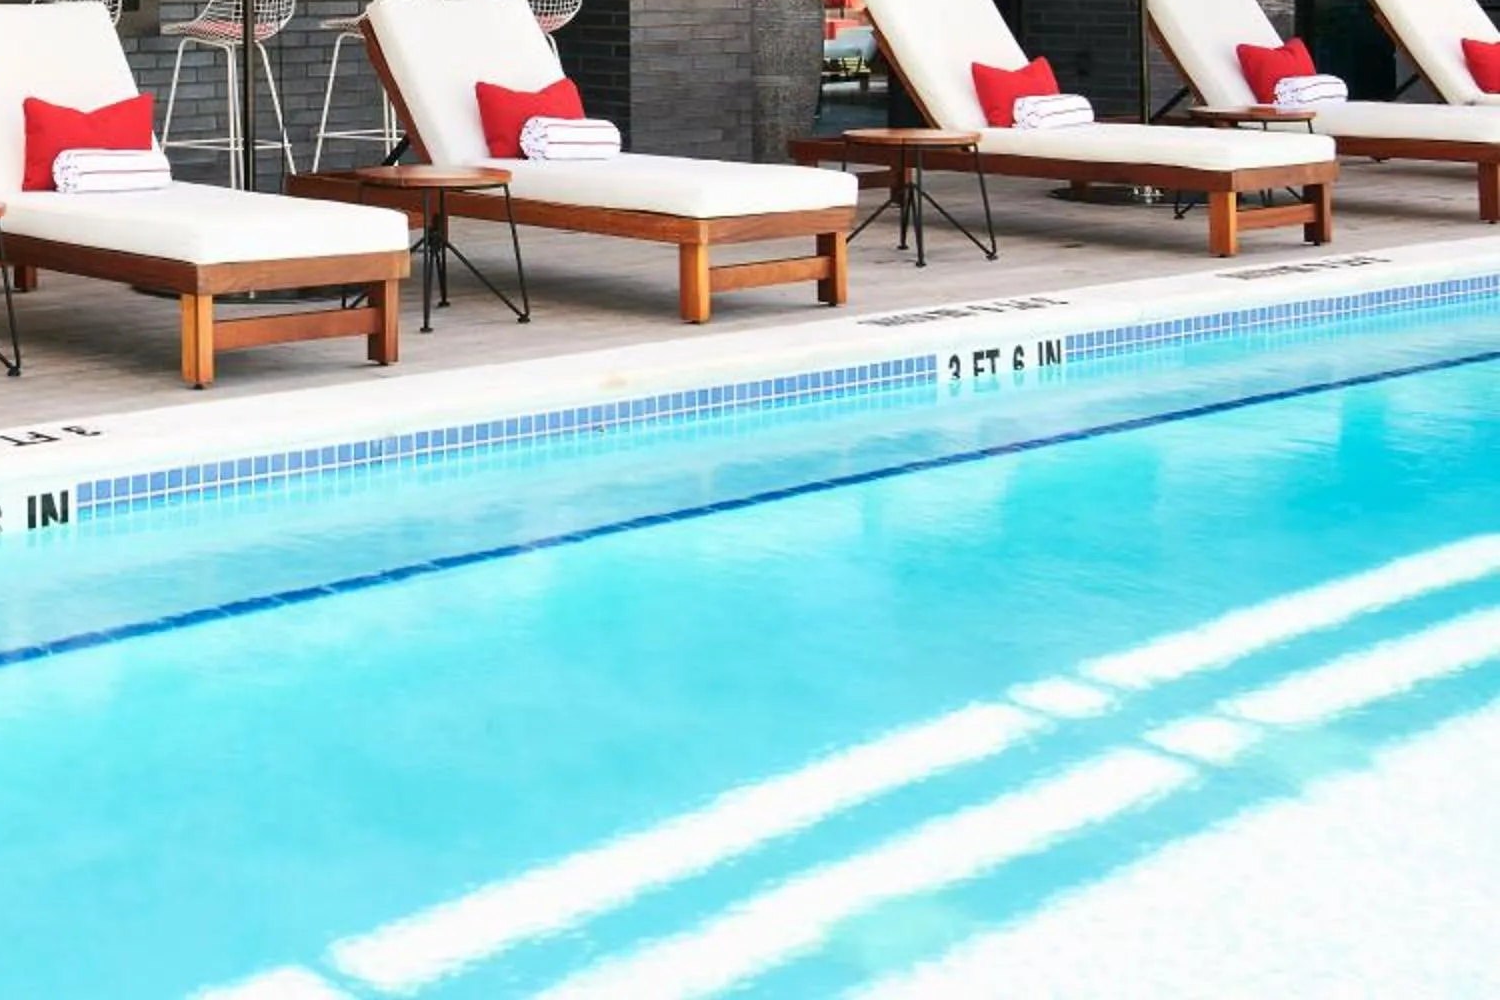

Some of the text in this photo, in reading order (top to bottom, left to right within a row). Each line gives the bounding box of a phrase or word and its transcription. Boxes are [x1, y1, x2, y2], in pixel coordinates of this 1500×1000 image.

[948, 339, 1062, 380] 3 FT 6 IN
[62, 426, 102, 437] 3
[27, 490, 69, 530] IN
